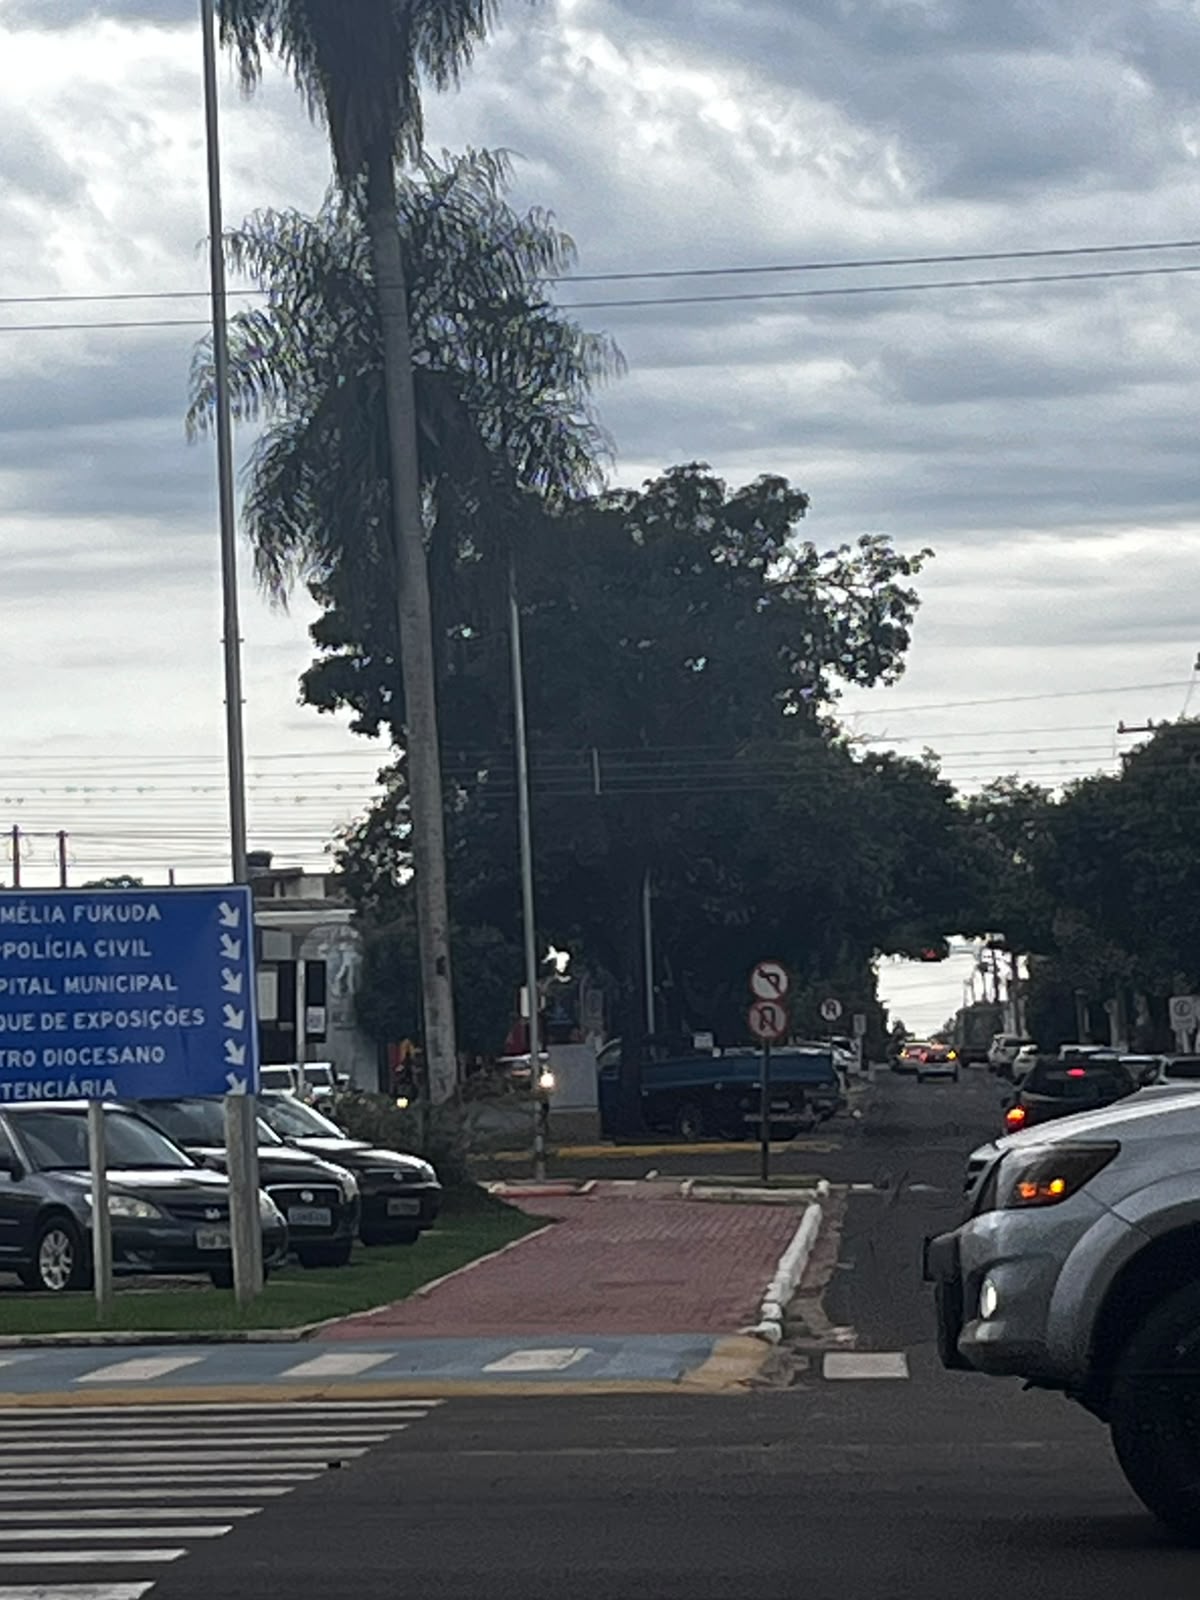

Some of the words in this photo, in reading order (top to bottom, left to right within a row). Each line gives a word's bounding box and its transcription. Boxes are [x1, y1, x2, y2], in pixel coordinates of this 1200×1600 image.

[0, 900, 66, 924] MÉLIA
[73, 904, 162, 922] FUKUDA
[94, 939, 152, 957] CIVIL
[64, 974, 178, 994] MUNICIPAL
[41, 1012, 68, 1031] DE
[74, 1004, 205, 1029] EXPOSIÇÕES
[43, 1046, 165, 1067] DIOCESANO
[0, 1073, 117, 1100] TENCIÁRIA
